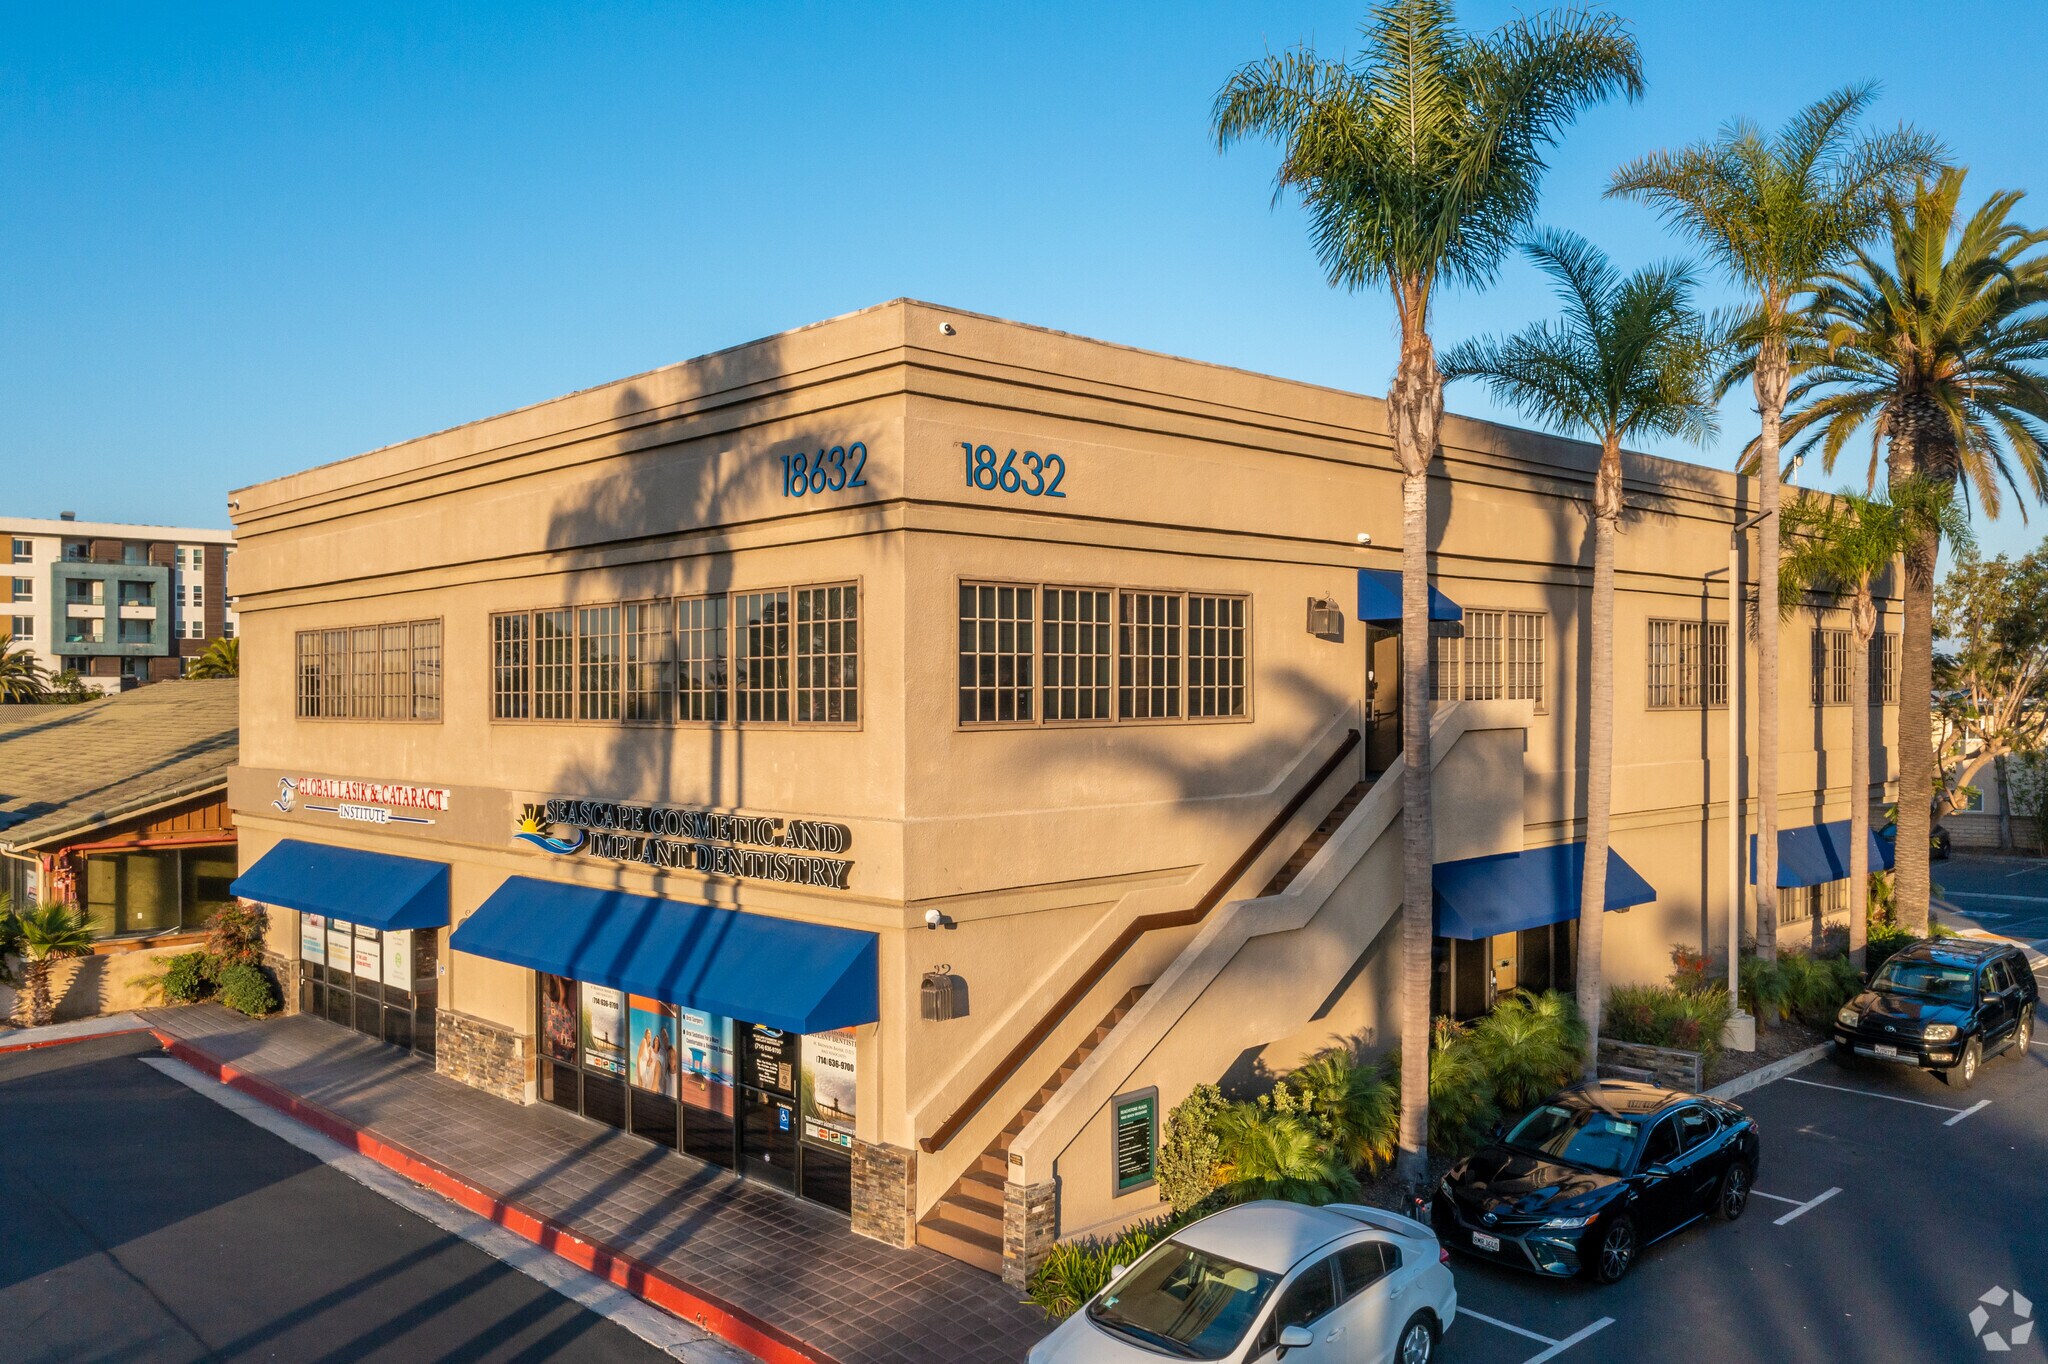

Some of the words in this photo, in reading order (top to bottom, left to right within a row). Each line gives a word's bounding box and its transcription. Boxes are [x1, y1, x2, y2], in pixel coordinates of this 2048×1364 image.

[780, 441, 867, 497] 18632
[961, 442, 1066, 498] 18632
[298, 777, 335, 798] GLOBAL
[337, 780, 368, 802] LASIK
[370, 784, 379, 803] &
[381, 785, 444, 811] CATARACT
[340, 805, 386, 822] INSTITUTE
[546, 800, 645, 833] SEASCAPE
[649, 808, 776, 848] COSMETIC
[781, 819, 844, 854] AND
[588, 831, 690, 869] IMPLANT
[694, 844, 846, 890] DENTISTRY
[828, 1058, 855, 1073] 636-9700
